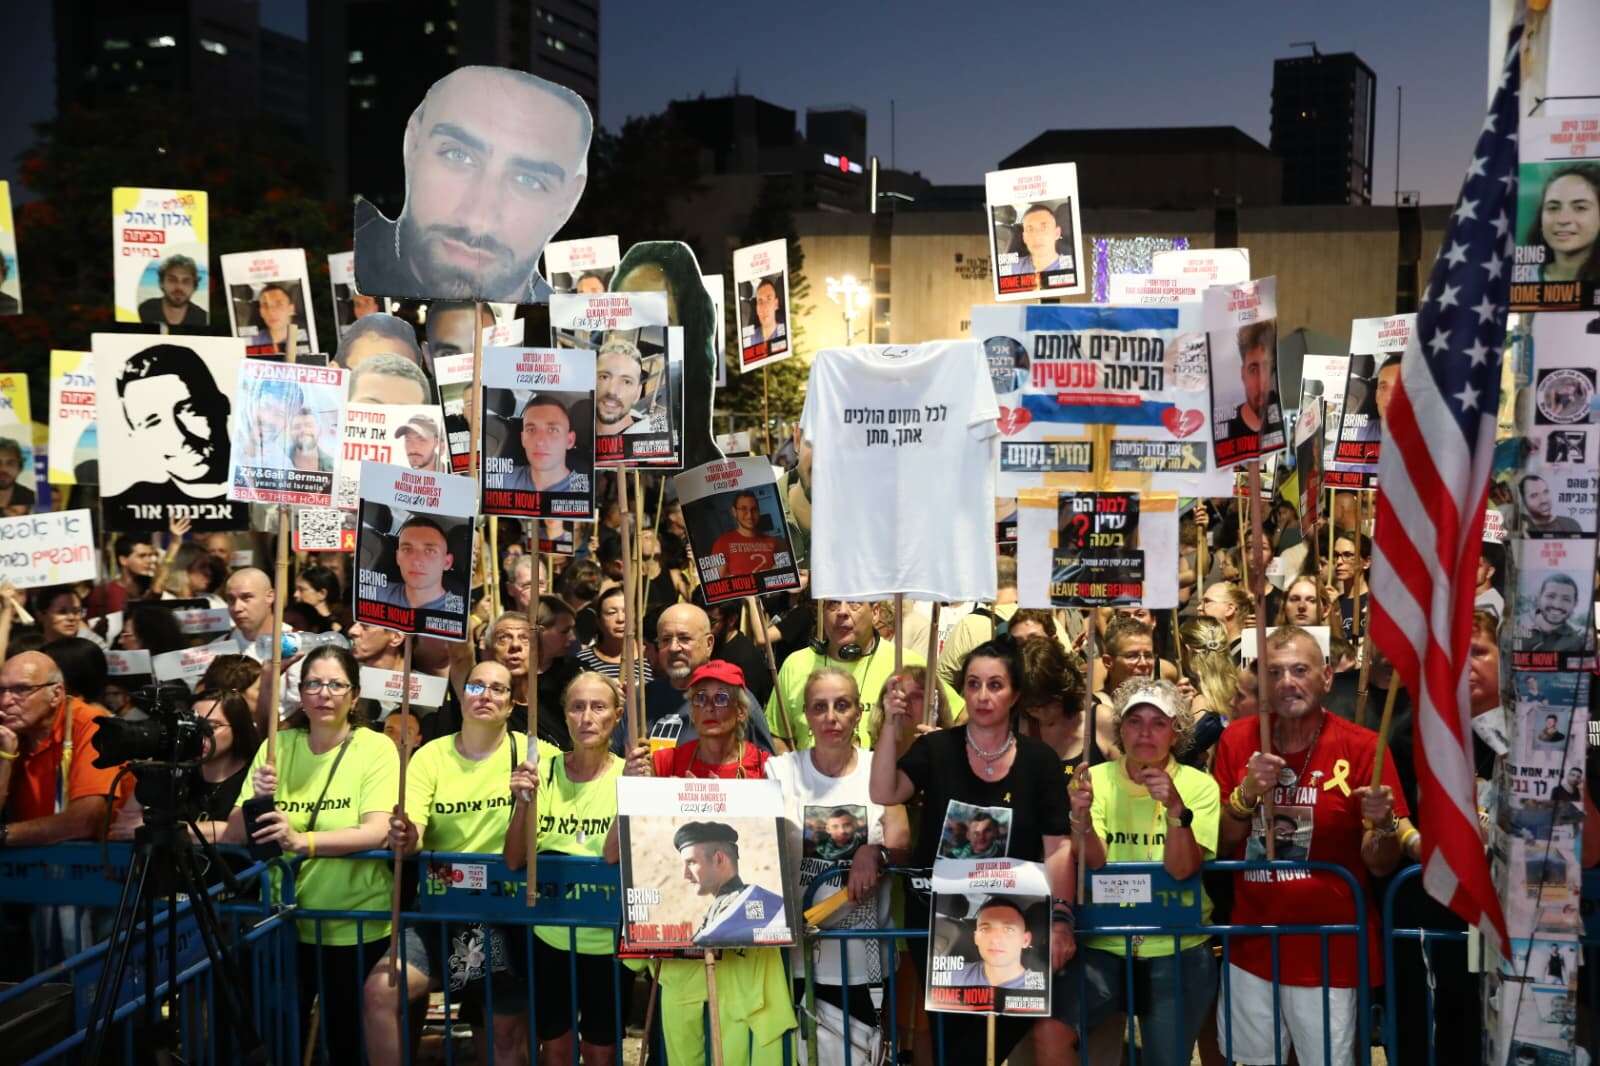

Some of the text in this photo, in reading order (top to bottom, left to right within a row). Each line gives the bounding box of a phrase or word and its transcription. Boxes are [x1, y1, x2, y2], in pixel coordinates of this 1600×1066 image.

[124, 209, 192, 228] אלון אהל
[123, 230, 165, 243] הביתה
[122, 246, 160, 258] בחיים
[1515, 245, 1545, 264] RING
[1543, 282, 1581, 304] NOW!
[1034, 335, 1082, 360] אותם
[1091, 337, 1164, 362] מחזירים
[1032, 362, 1098, 391] עכשיו!
[1103, 364, 1164, 391] הביתה
[348, 410, 386, 424] מחזירים
[844, 404, 947, 426] לכל מקום הולכים
[1344, 414, 1369, 428] BRING
[345, 426, 386, 440] את איתי
[866, 430, 889, 447] מתן
[486, 457, 514, 473] BRING
[486, 473, 504, 488] HIM
[413, 484, 441, 497] ANGREST
[1558, 493, 1588, 503] הביתה
[486, 492, 540, 510] HOME NOW!
[1072, 496, 1128, 512] למה הם
[127, 504, 162, 519] אור
[1095, 515, 1127, 533] עדין
[1090, 534, 1125, 547] בעזה
[699, 553, 726, 570] BRING
[359, 569, 387, 587] BRING
[702, 567, 721, 582] HIM
[359, 583, 377, 600] HIM
[1051, 583, 1079, 597] LEAVE
[1090, 583, 1108, 597] ONE
[358, 600, 416, 625] HOME NOW!
[1533, 780, 1547, 796] לך
[274, 797, 351, 813] אנחנ איתכ
[678, 793, 727, 802] MATAN ANGREST
[435, 801, 483, 815] איתכם
[560, 814, 582, 835] לא
[1107, 833, 1139, 845] איתכ
[968, 872, 989, 881] MATAN
[627, 888, 660, 904] BRING
[628, 905, 649, 921] HIM
[629, 922, 693, 941] HOME NOW!
[933, 956, 964, 971] BRING
[931, 971, 952, 986] HIM
[932, 987, 960, 1002] HOME
[964, 987, 994, 1004] NOW!
